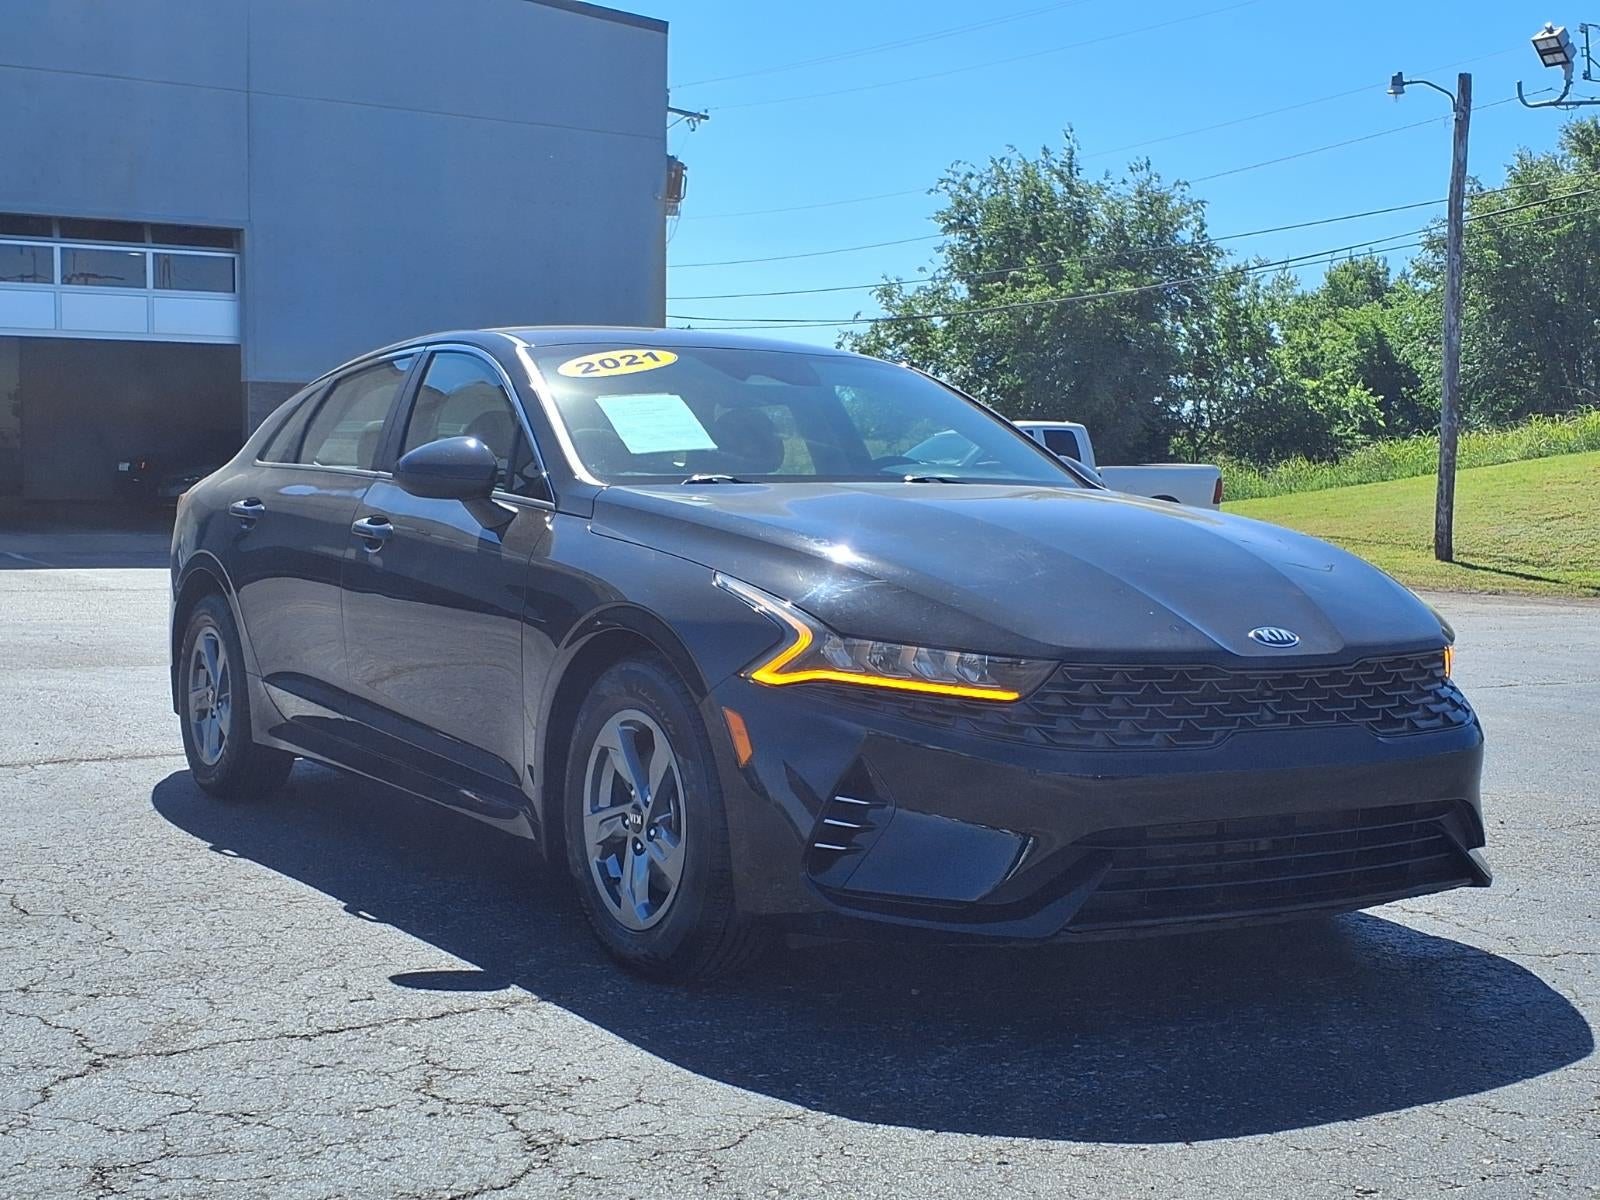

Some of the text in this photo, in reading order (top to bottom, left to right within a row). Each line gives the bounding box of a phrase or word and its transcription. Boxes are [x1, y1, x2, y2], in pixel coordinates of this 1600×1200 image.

[575, 351, 661, 375] 2021
[1257, 628, 1295, 641] KIA
[629, 812, 642, 825] KIA
